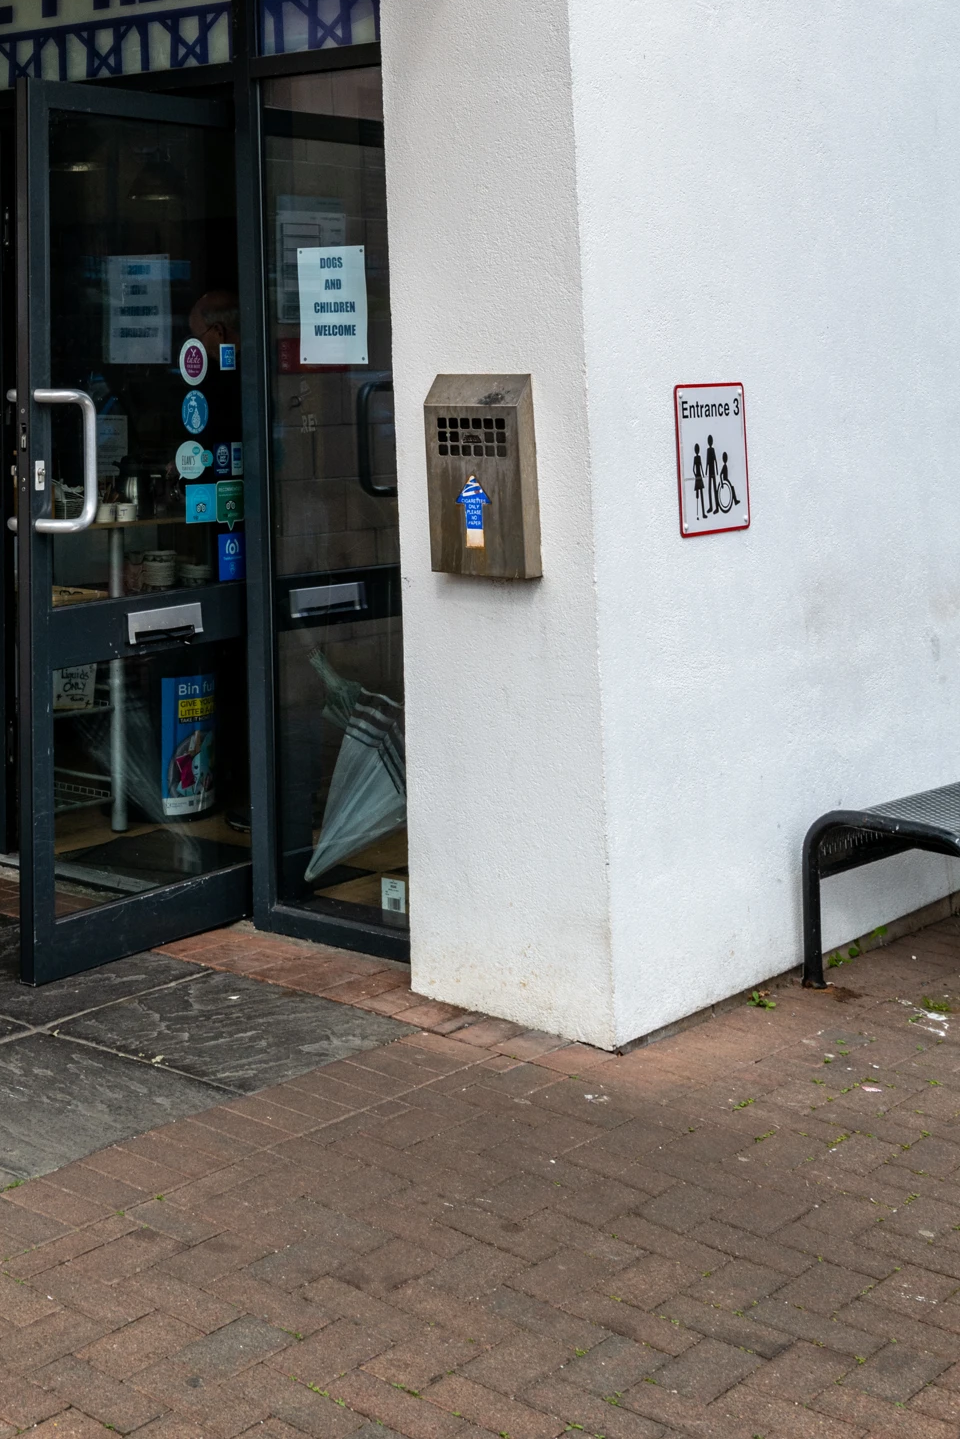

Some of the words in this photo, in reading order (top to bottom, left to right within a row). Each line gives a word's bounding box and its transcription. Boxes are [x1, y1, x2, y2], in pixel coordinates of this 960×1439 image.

[320, 257, 343, 269] DOGS
[324, 279, 342, 291] AND
[314, 302, 356, 314] CHILDREN
[314, 325, 356, 337] WELCOME
[682, 399, 731, 419] Entrance
[732, 398, 740, 417] 3
[62, 668, 89, 682] Liquids
[63, 682, 86, 692] ONLY
[178, 682, 199, 696] Bin
[203, 679, 215, 693] ful
[181, 708, 204, 716] LITTER
